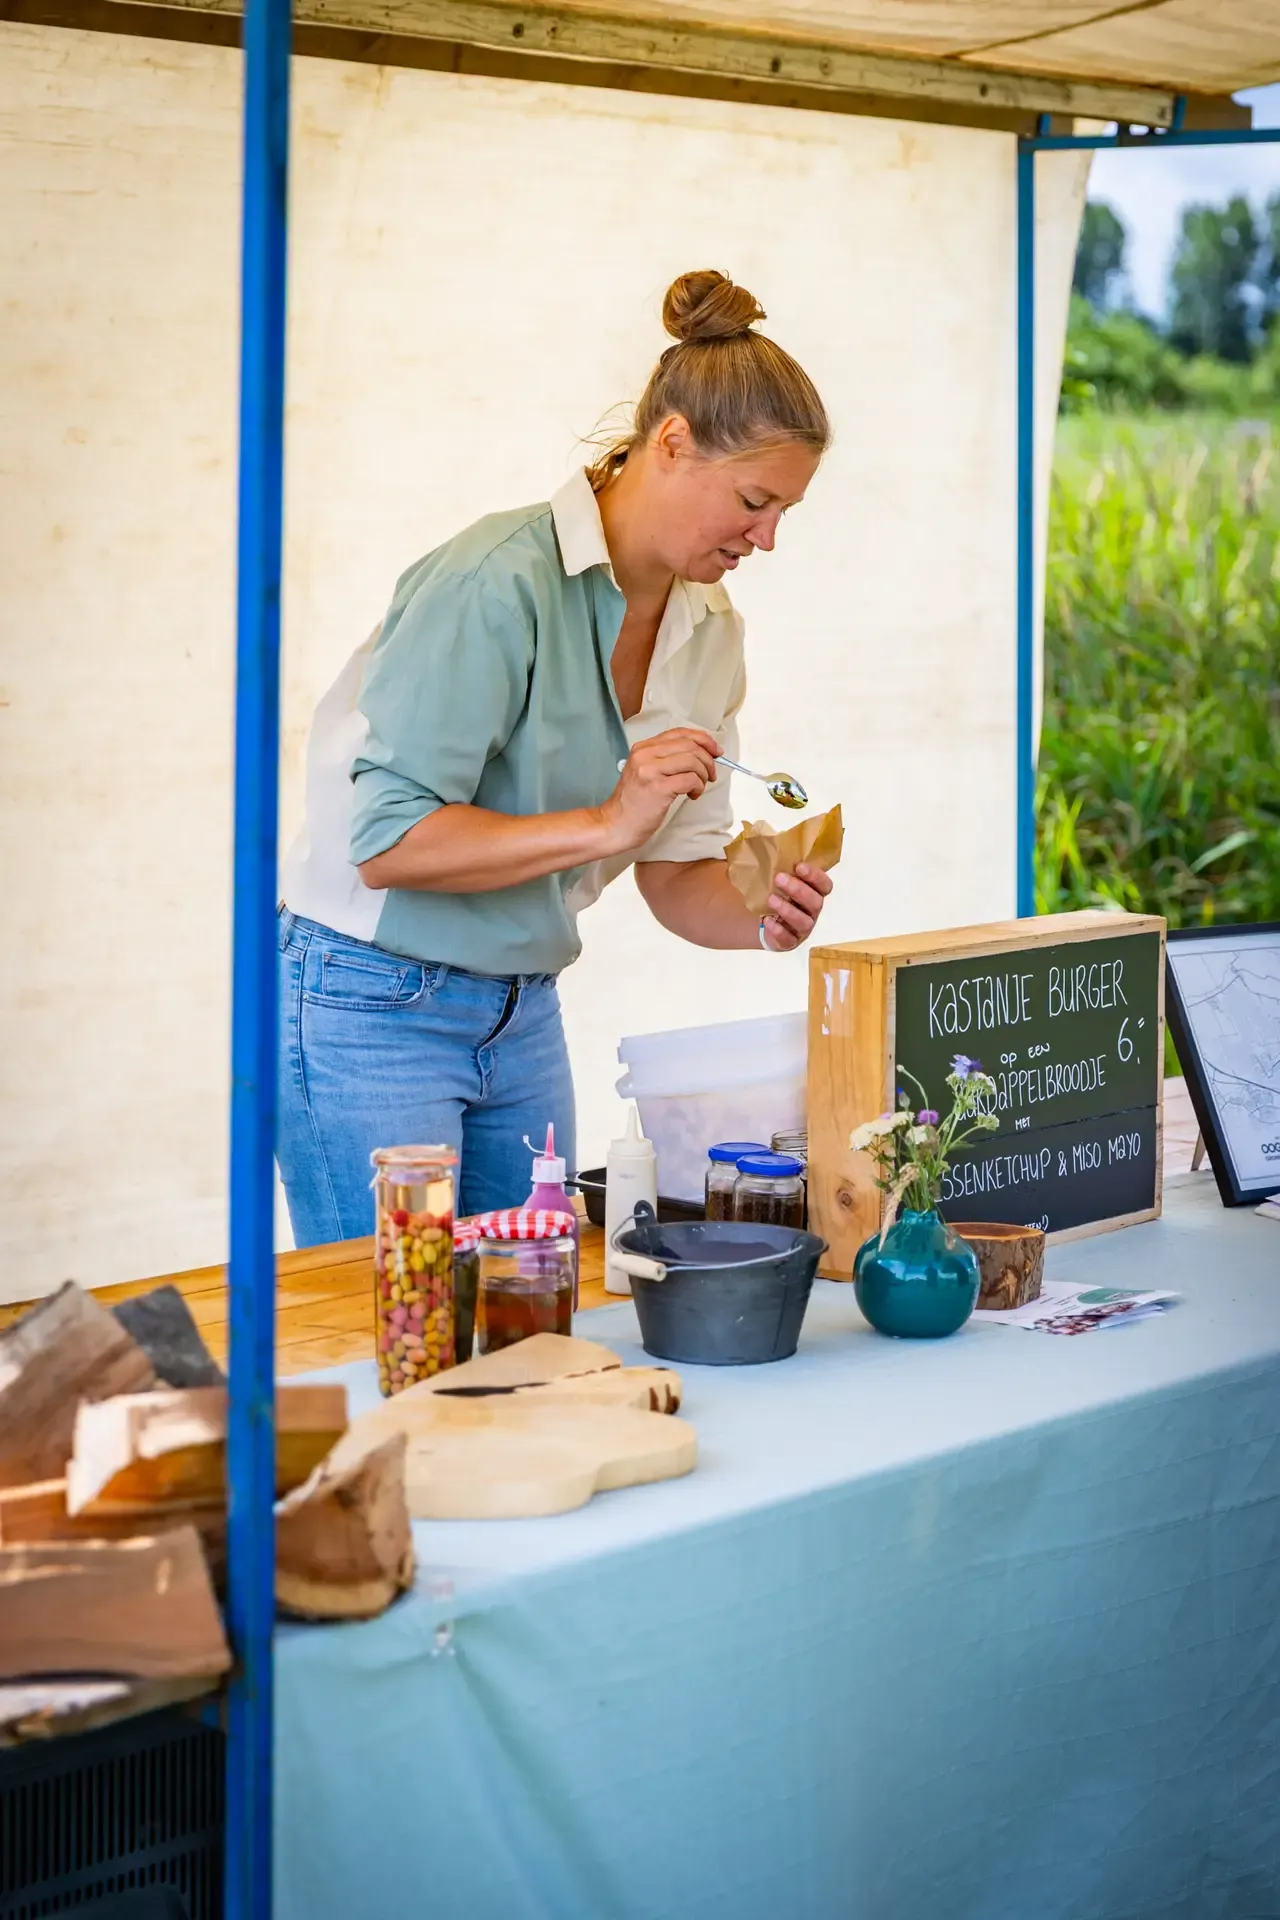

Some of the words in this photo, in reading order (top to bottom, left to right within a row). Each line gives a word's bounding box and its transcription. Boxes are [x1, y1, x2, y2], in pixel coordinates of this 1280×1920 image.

[1049, 959, 1128, 1017] BURGER
[1015, 1116, 1031, 1130] MET
[934, 1147, 1051, 1202] SSENKETCHUP
[1058, 1150, 1068, 1176] &
